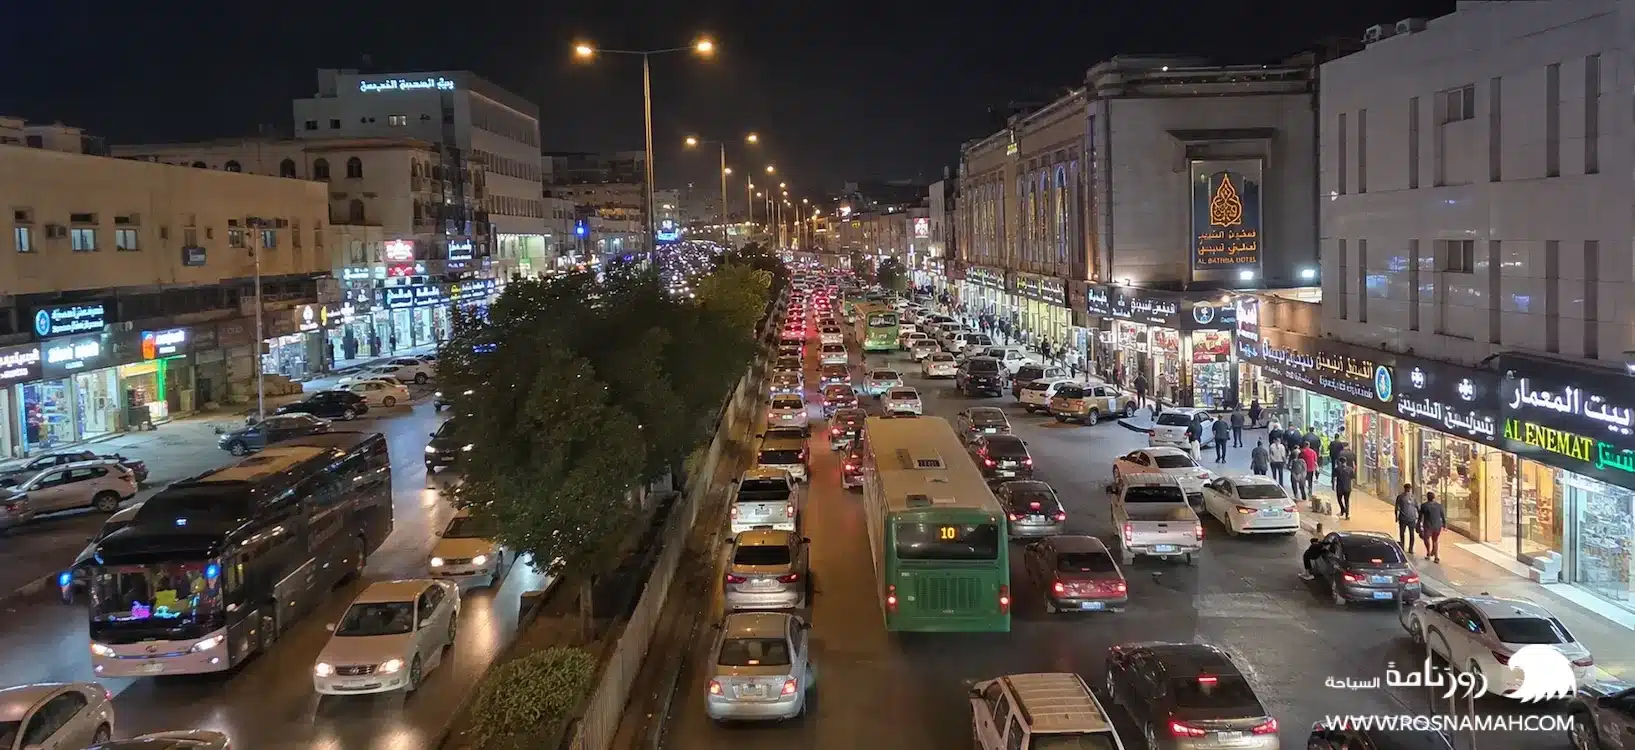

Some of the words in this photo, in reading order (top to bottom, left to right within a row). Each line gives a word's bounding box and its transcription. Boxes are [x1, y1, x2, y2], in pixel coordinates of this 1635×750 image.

[1509, 377, 1579, 414] المعمار
[1503, 416, 1522, 442] AL
[1524, 422, 1593, 462] ENEMAT
[940, 526, 955, 539] 10
